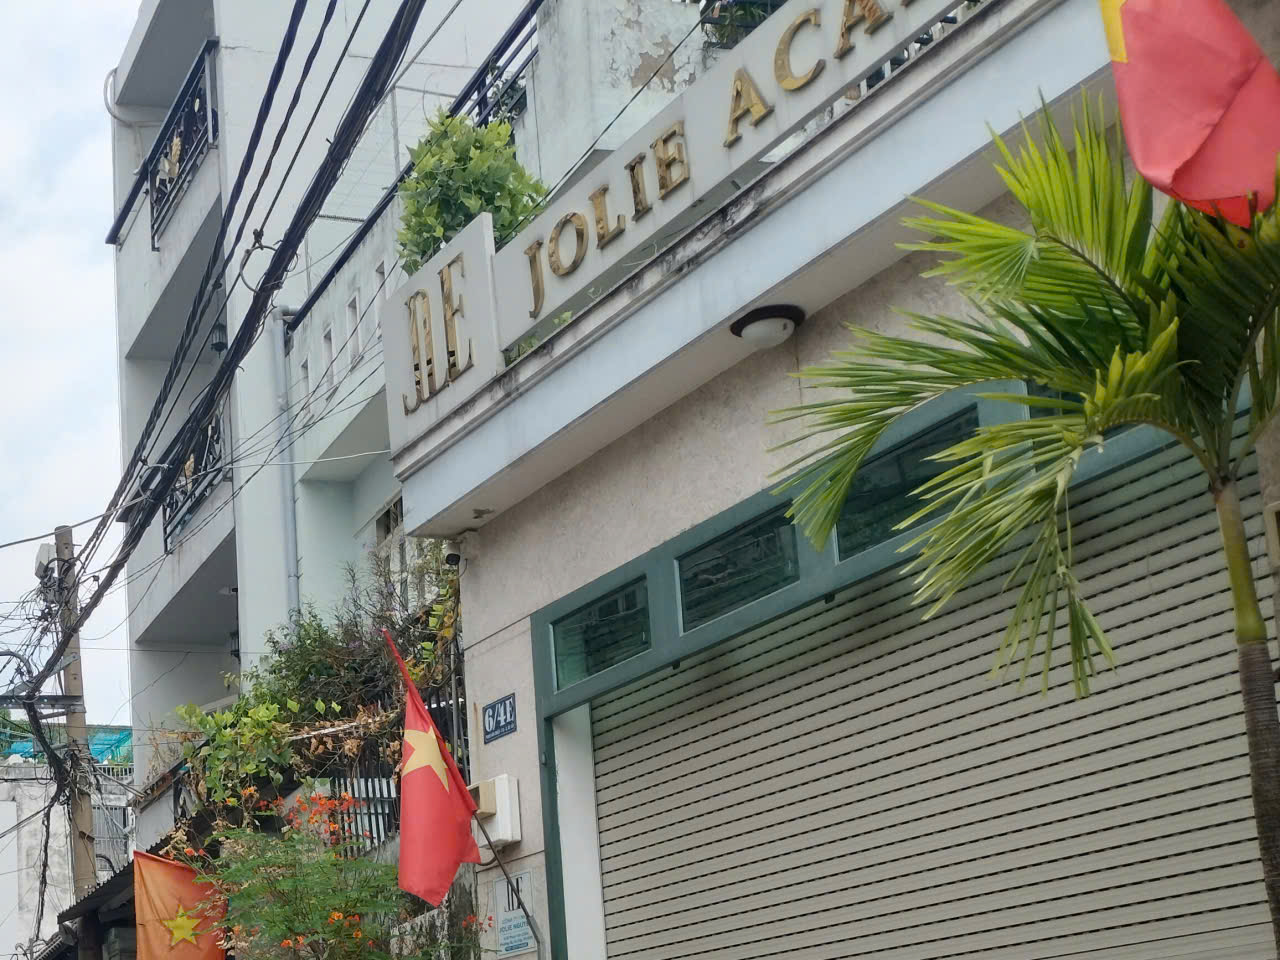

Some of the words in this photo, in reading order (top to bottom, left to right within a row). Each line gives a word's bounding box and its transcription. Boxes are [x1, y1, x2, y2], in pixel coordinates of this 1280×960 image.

[523, 119, 690, 319] JOLIE
[723, 0, 919, 149] ACA
[485, 697, 514, 732] 6/4E
